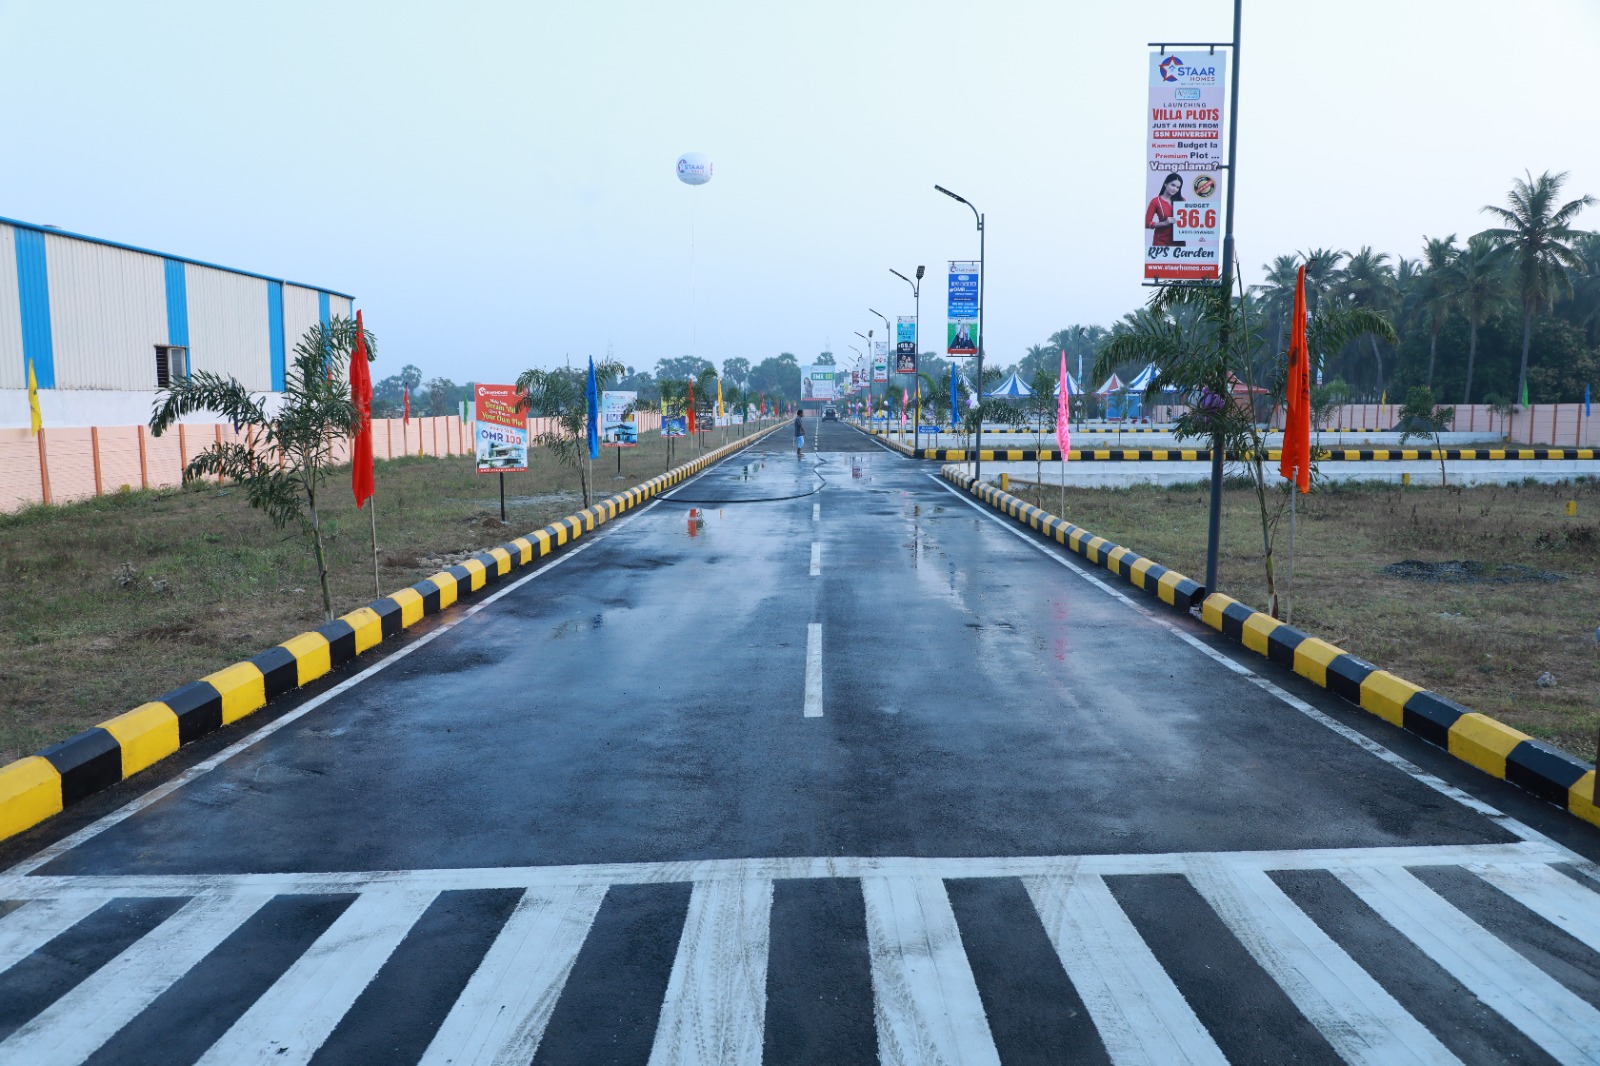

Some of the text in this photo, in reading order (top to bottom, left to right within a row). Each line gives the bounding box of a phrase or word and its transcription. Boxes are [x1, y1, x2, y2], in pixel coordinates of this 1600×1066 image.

[1178, 67, 1215, 76] STAAR
[1152, 108, 1219, 121] VILLA PLOTS
[1149, 161, 1219, 172] Vangalama?
[1177, 209, 1216, 228] 36.6
[1148, 246, 1214, 259] RPS Garden
[481, 411, 496, 420] Your
[481, 430, 522, 445] OMR 100
